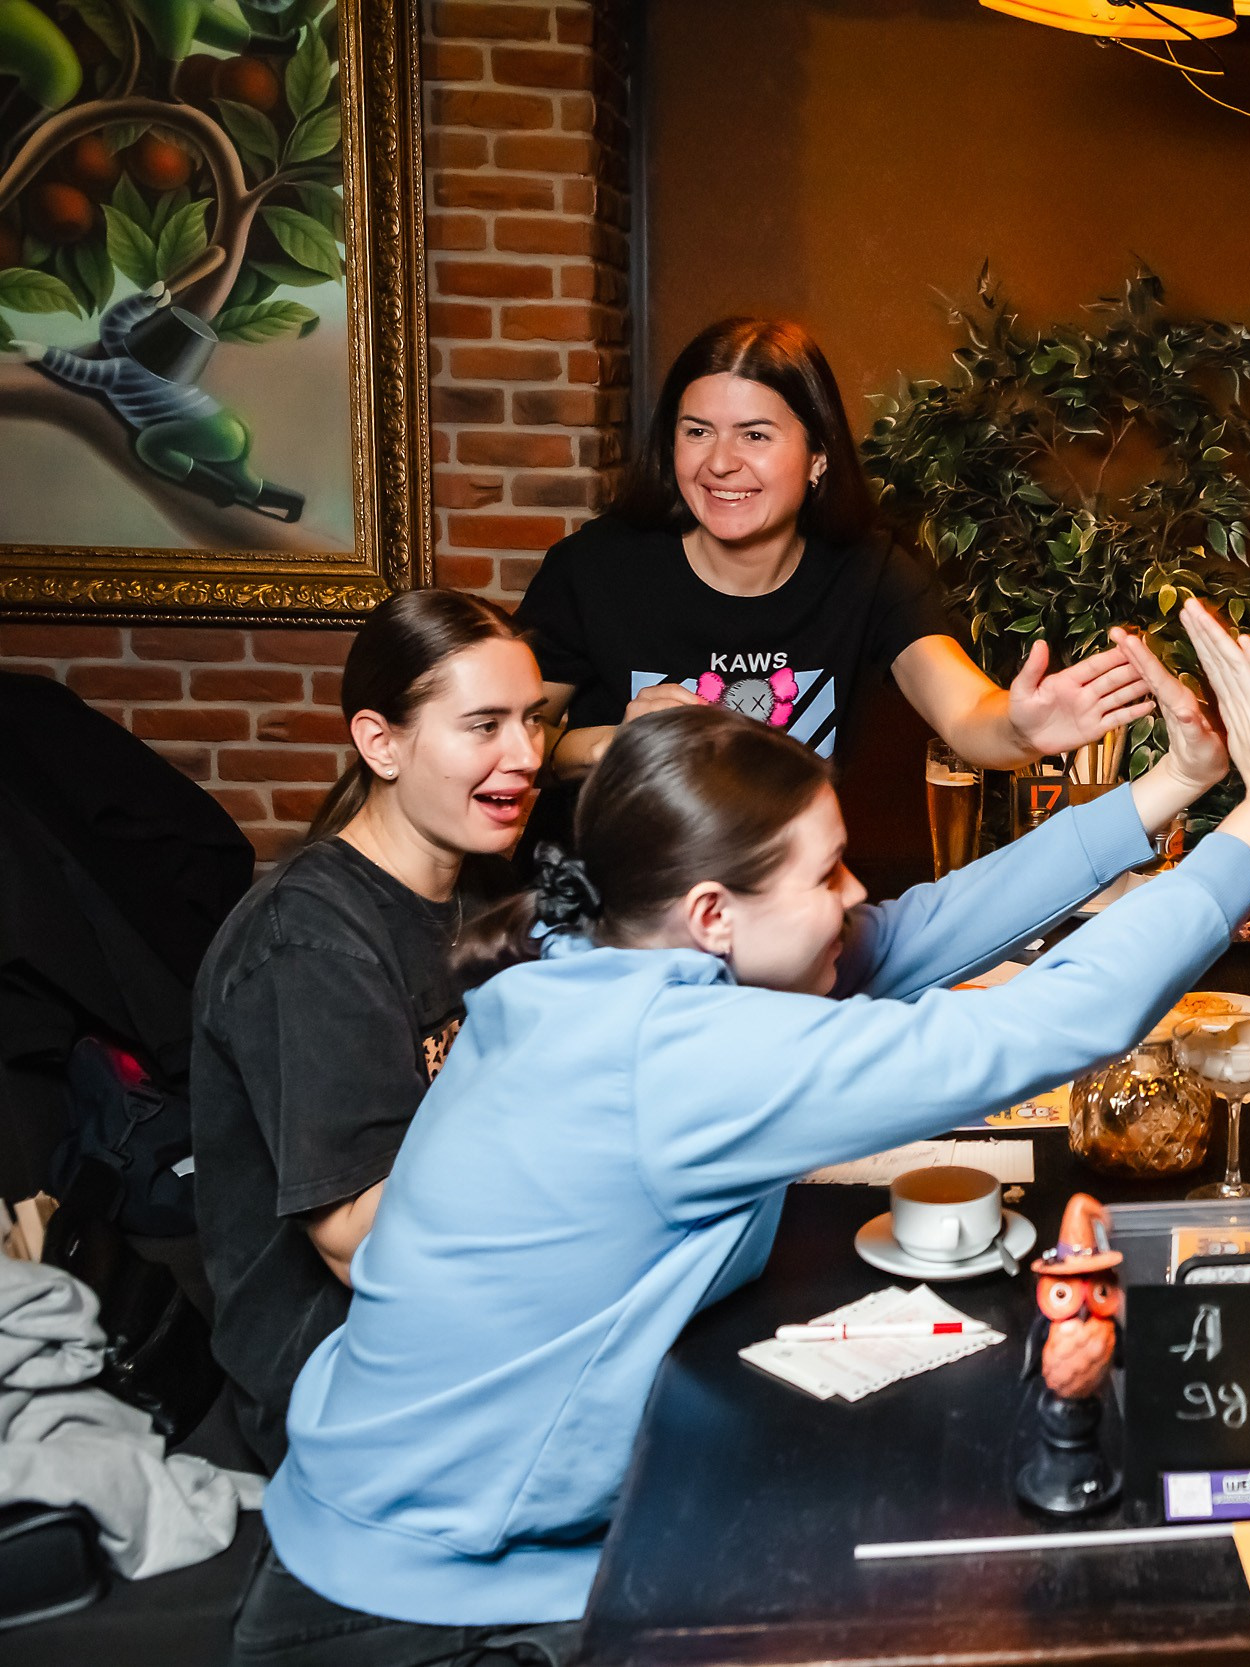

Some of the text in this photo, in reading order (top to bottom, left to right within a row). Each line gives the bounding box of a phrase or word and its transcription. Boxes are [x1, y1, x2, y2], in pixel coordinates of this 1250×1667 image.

[710, 652, 788, 672] KAWS
[1031, 785, 1062, 810] 17
[1169, 1304, 1222, 1362] А
